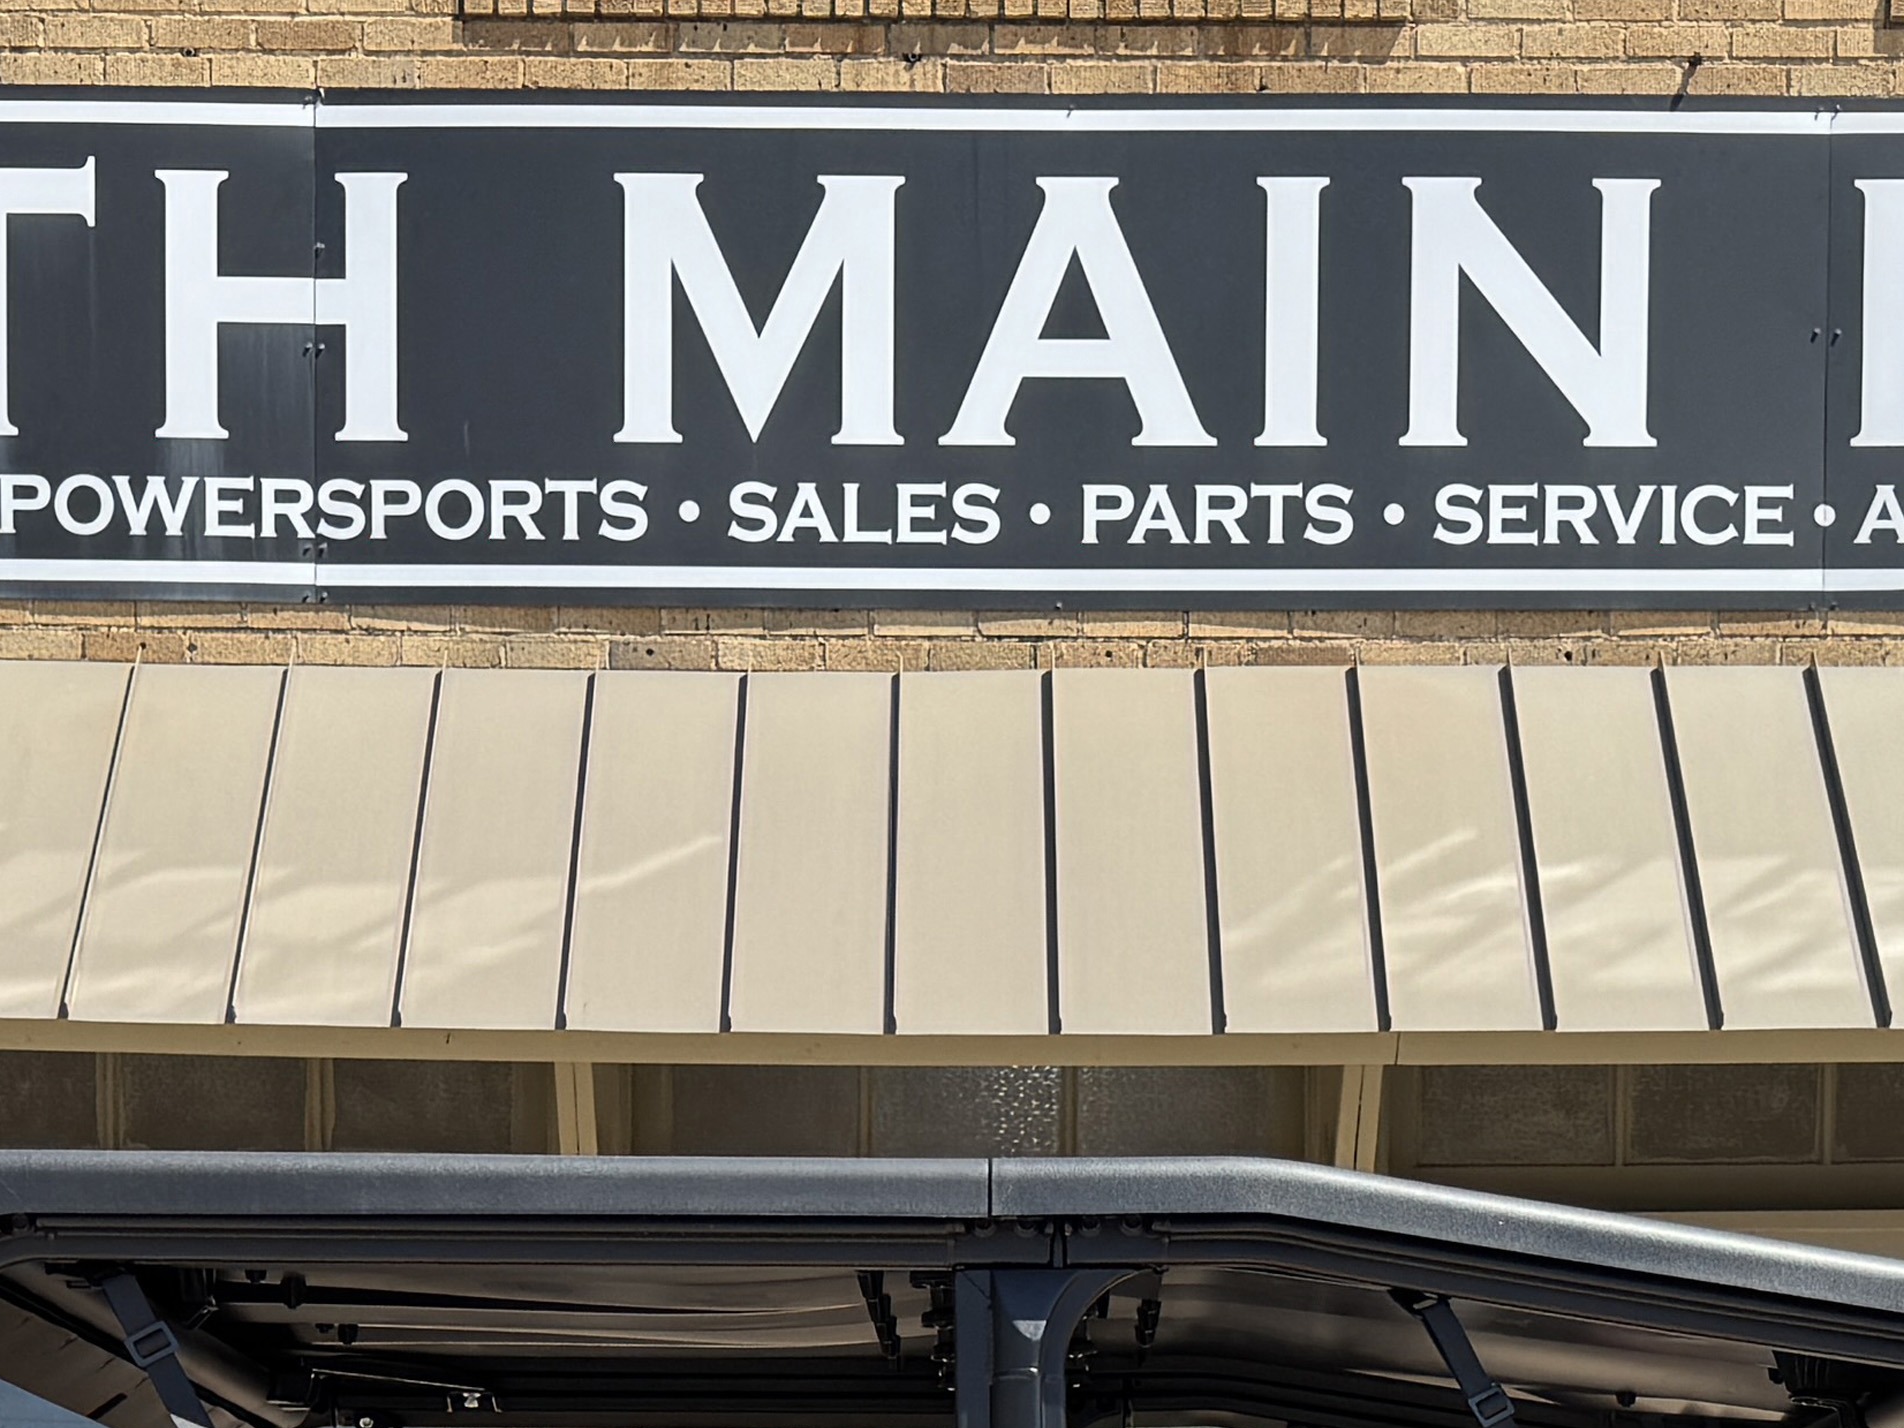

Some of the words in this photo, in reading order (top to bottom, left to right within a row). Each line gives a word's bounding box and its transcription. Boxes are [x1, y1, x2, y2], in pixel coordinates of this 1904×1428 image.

[612, 171, 1663, 449] MAIN
[726, 480, 1002, 546] SALES
[1080, 481, 1355, 546] PARTS
[1432, 482, 1795, 548] SERVICE
